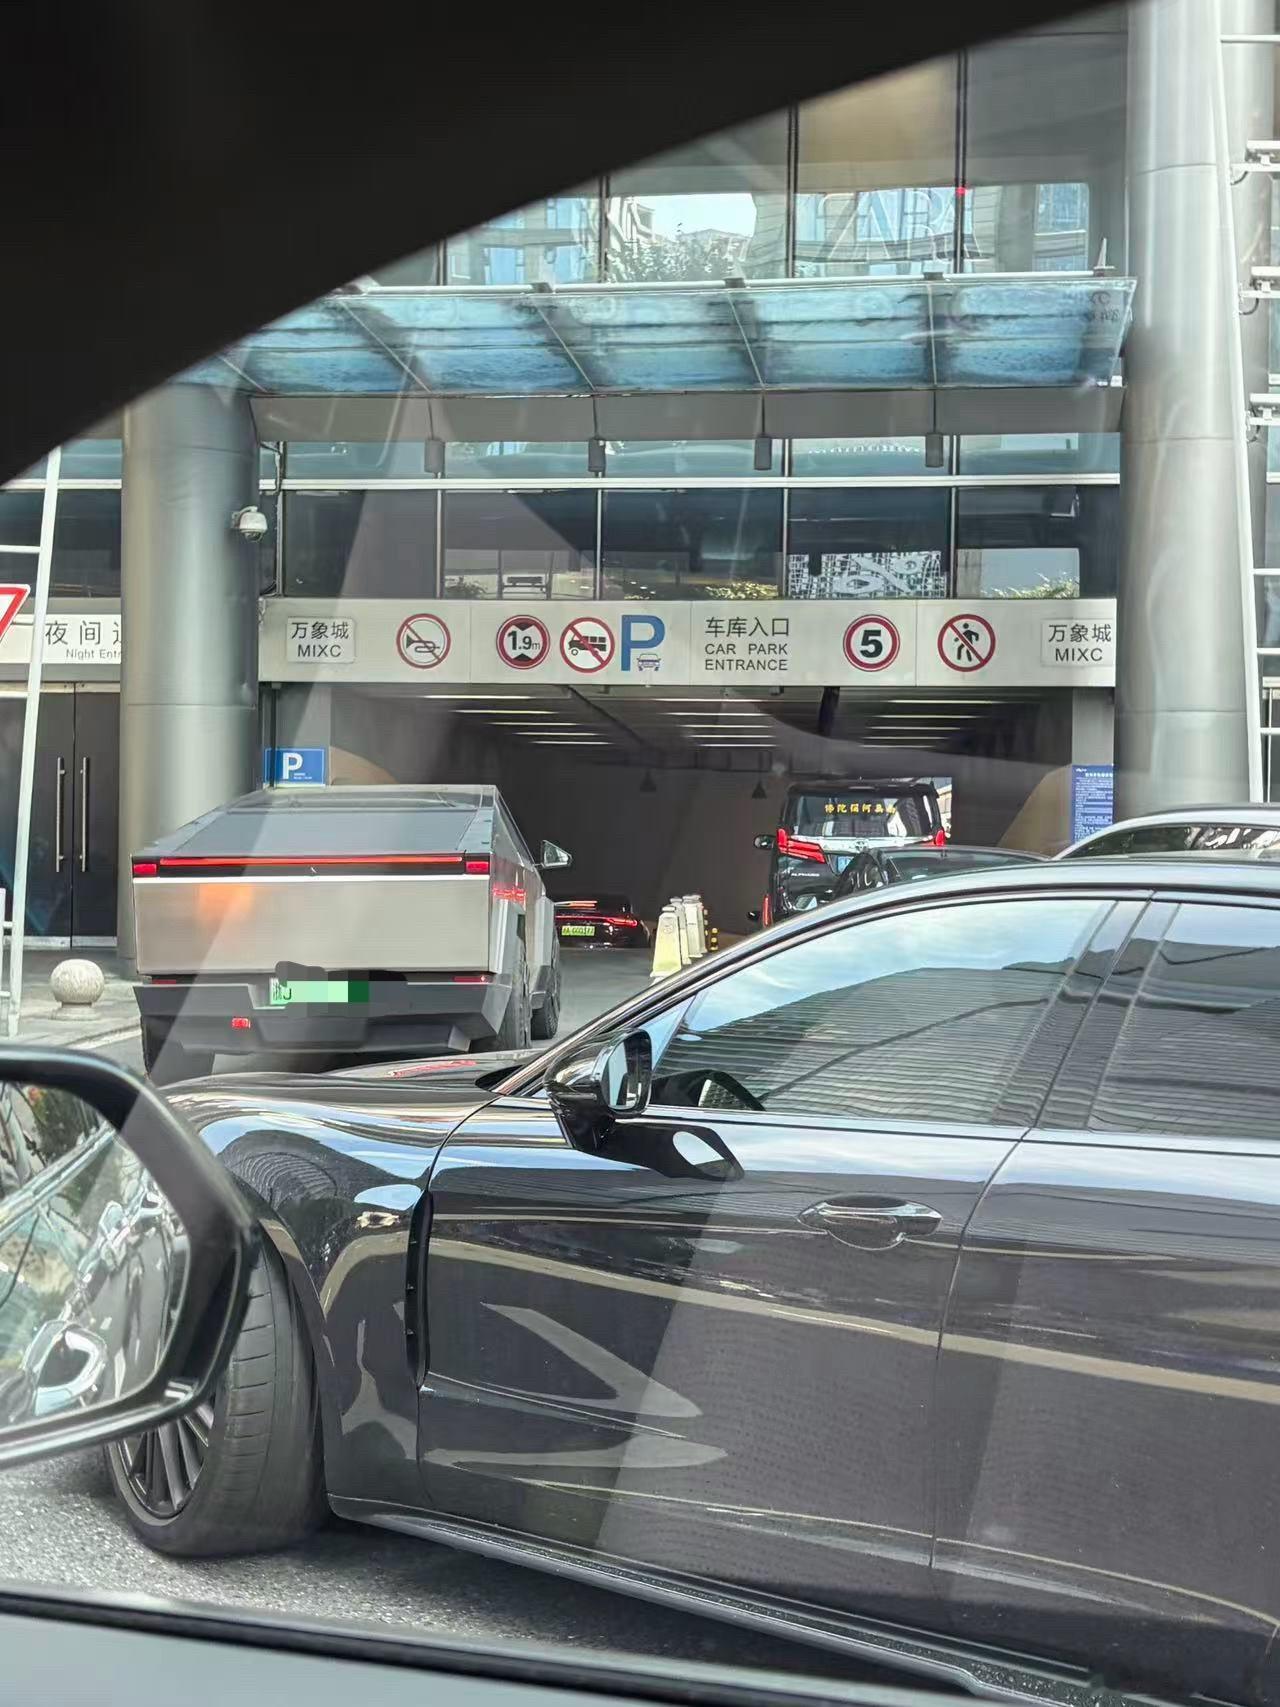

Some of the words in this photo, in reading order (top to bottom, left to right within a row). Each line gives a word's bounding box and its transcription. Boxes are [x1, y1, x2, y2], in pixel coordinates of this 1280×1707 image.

[291, 621, 349, 639] 万象城
[705, 617, 790, 638] 车库入口
[1048, 623, 1112, 643] 万象城
[507, 630, 541, 651] 1.9m
[620, 614, 666, 672] P
[705, 643, 737, 656] CAR
[748, 643, 789, 656] PARK
[859, 629, 883, 659] 5
[66, 648, 95, 660] Night
[297, 644, 342, 658] MIXC
[1055, 647, 1103, 662] MIXC
[705, 659, 789, 671] ENTRANCE
[282, 752, 304, 780] P
